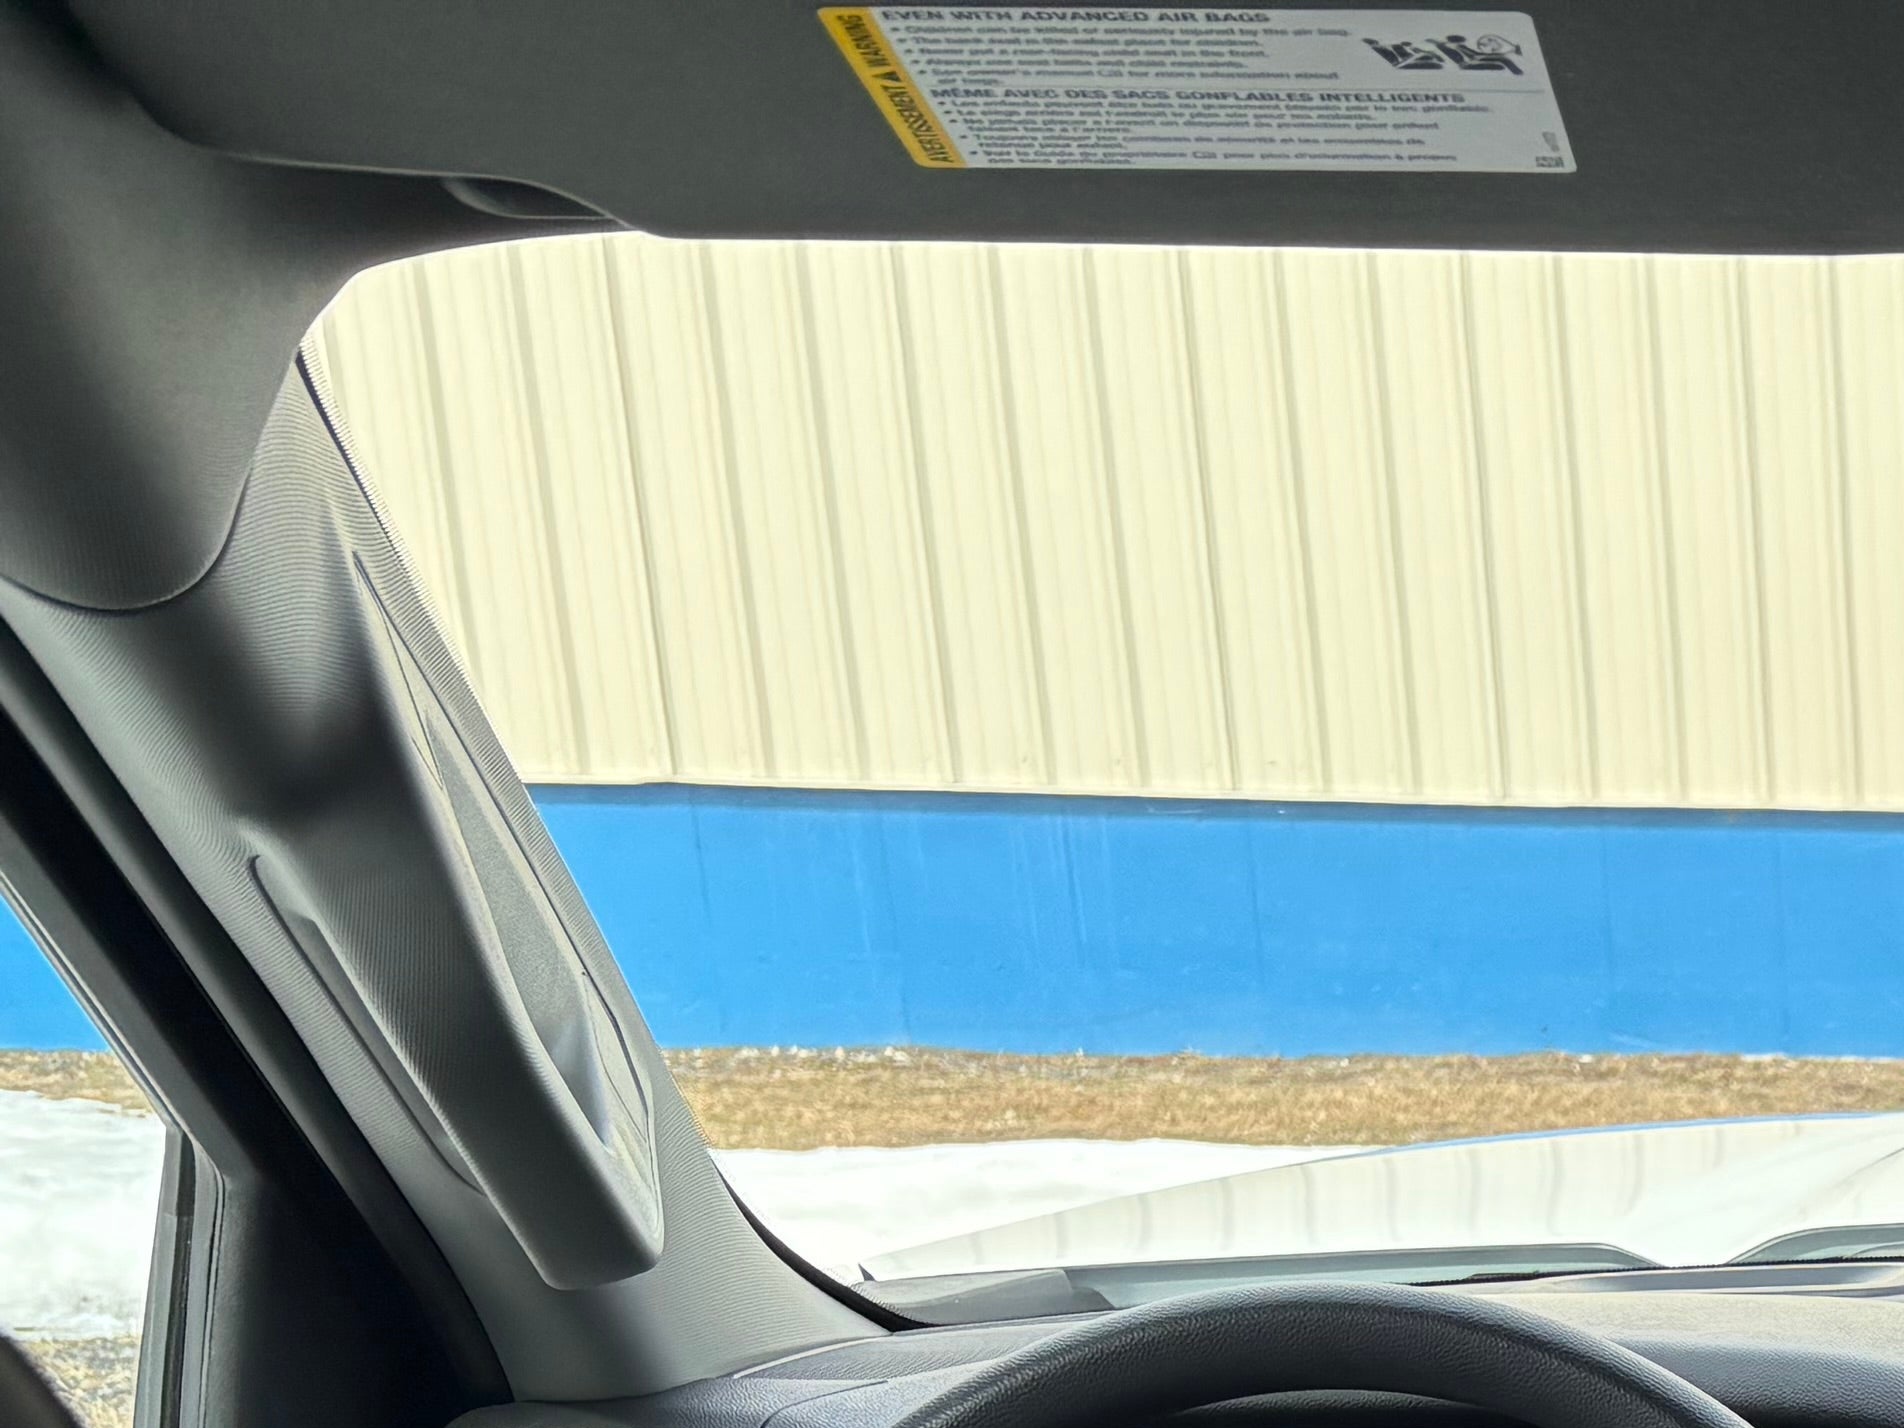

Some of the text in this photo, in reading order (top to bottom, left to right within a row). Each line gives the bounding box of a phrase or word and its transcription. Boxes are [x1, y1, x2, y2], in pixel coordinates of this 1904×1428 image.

[882, 10, 1270, 23] EVEN WITH ADVANCED AIR BAGS
